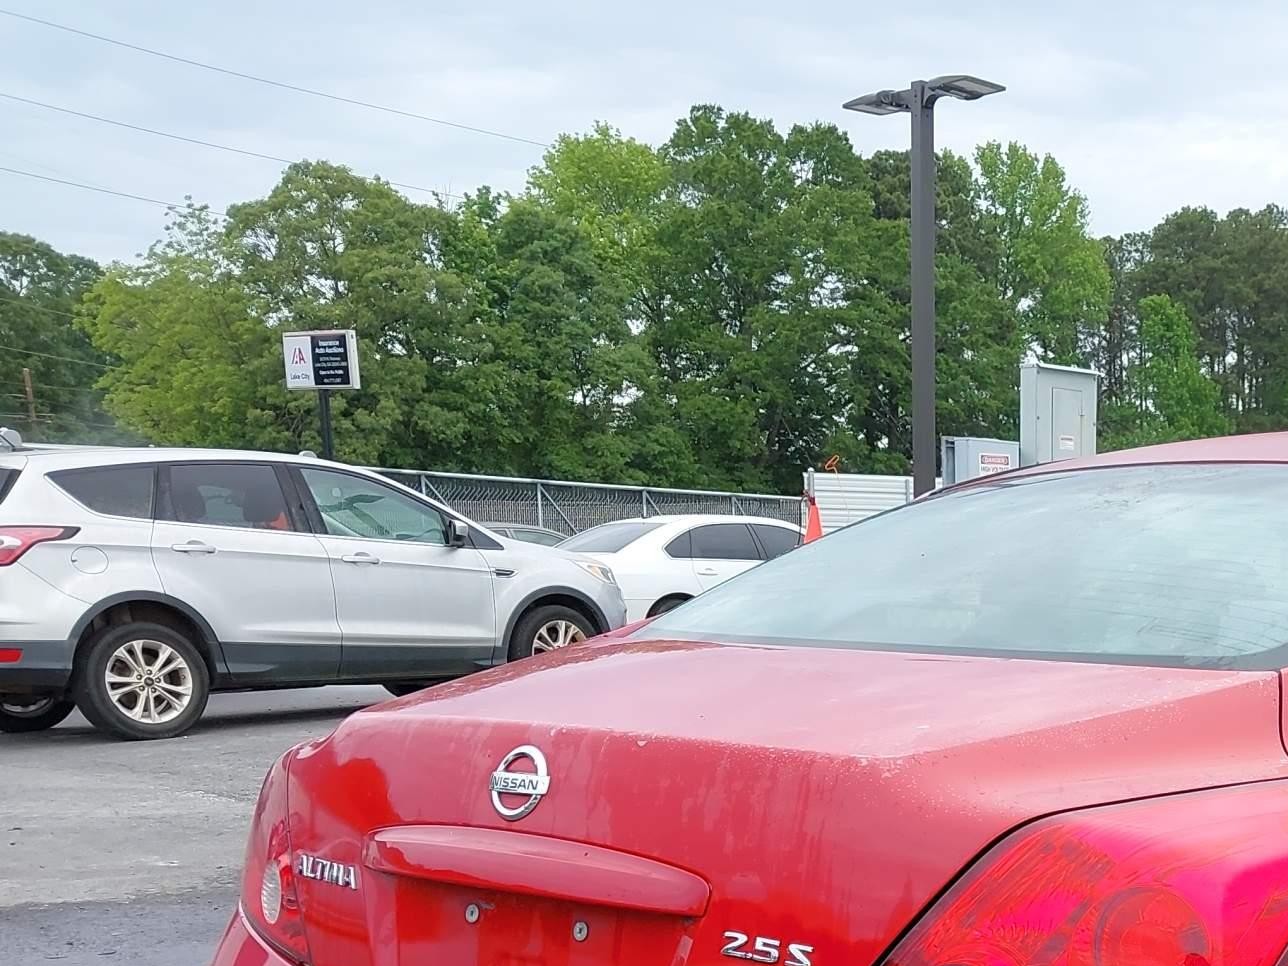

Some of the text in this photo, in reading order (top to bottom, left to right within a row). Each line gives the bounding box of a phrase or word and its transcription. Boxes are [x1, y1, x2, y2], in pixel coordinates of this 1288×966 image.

[301, 373, 310, 381] City
[492, 775, 539, 791] NISSAN
[298, 854, 357, 890] ALTIMA
